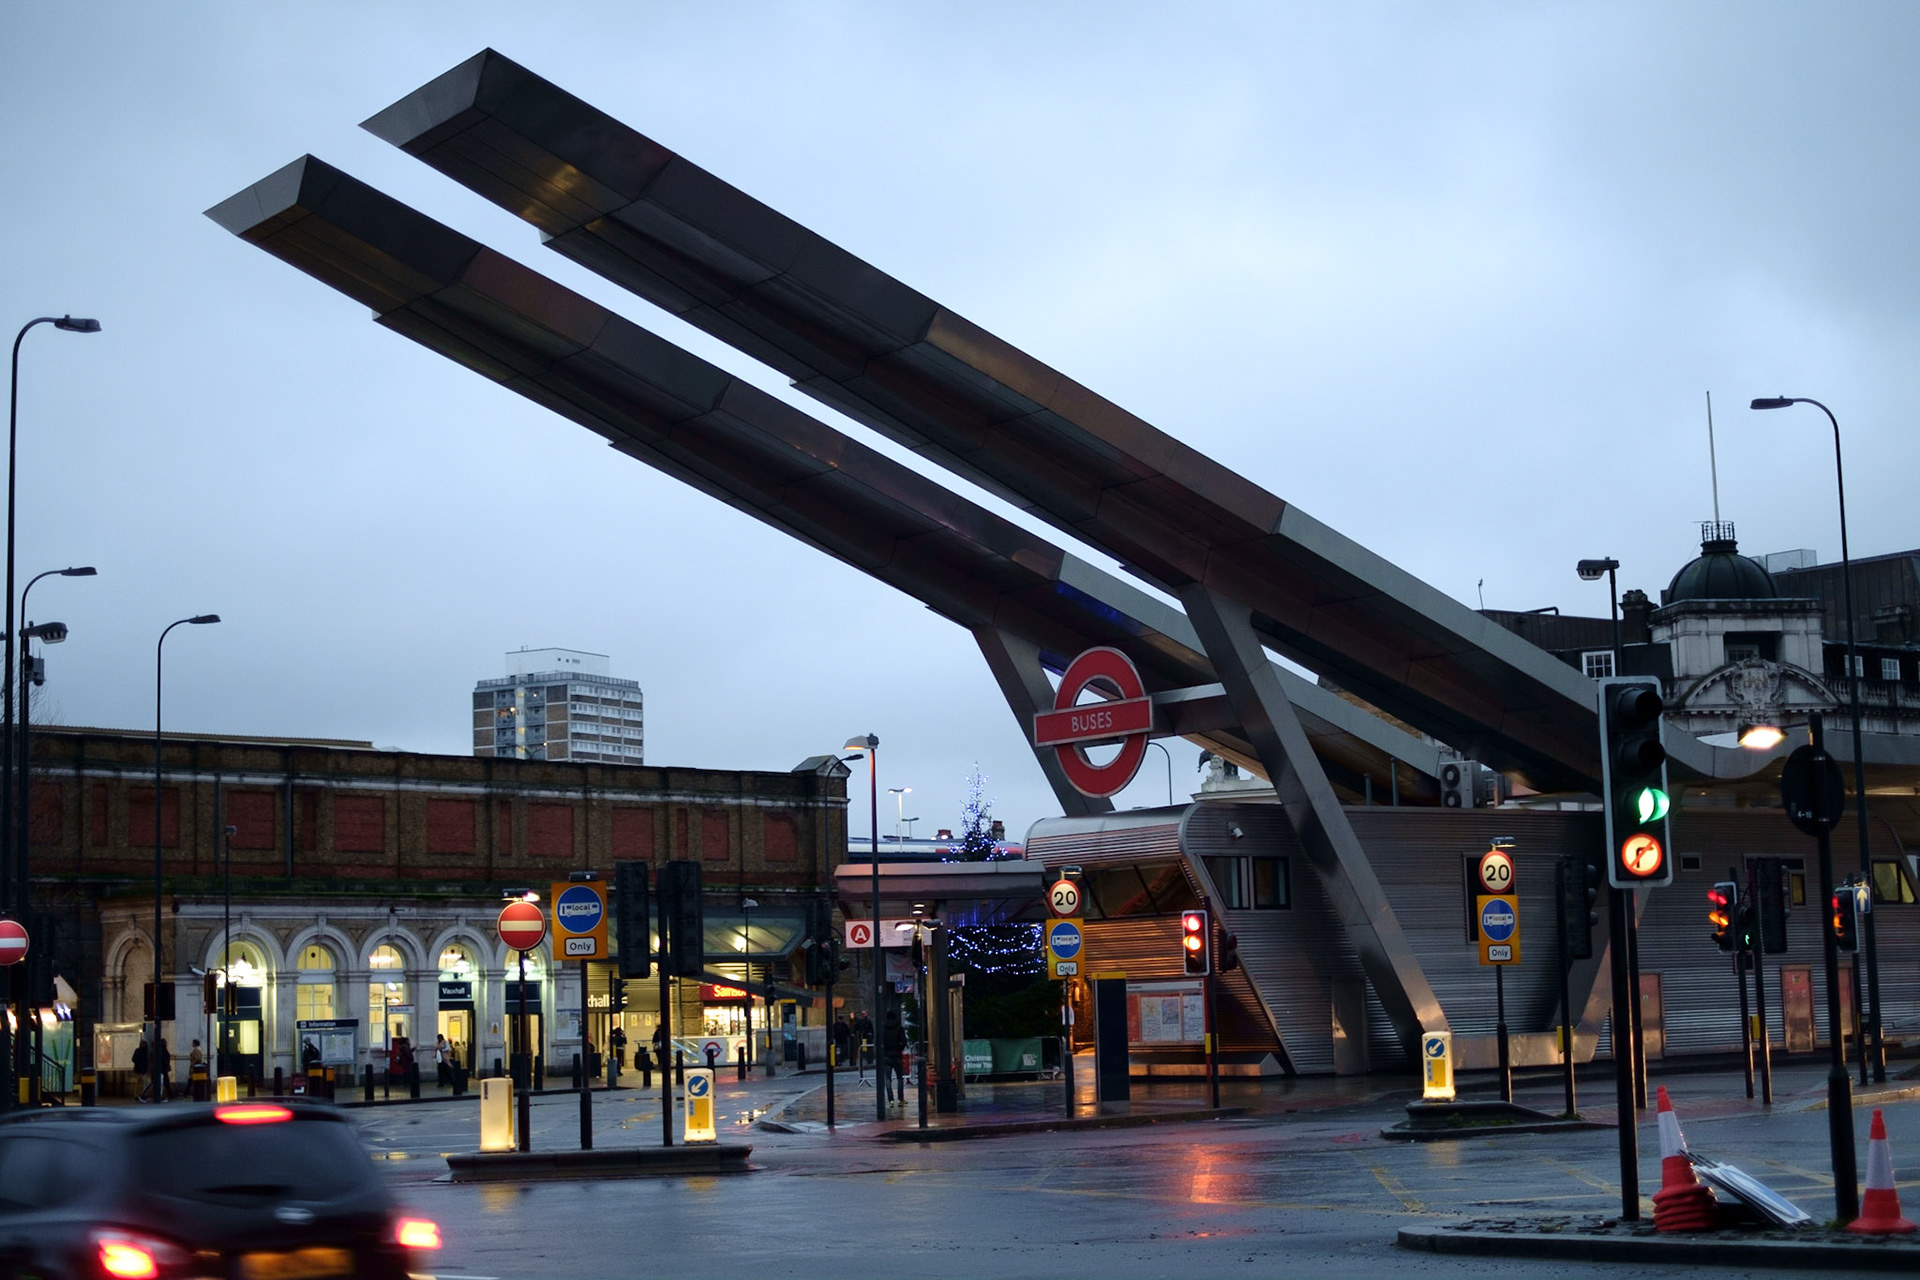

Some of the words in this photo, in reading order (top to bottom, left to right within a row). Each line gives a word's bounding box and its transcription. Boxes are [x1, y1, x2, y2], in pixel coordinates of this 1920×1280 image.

[1071, 711, 1113, 732] BUSES
[1485, 864, 1510, 881] 20
[1054, 890, 1077, 906] 20
[1492, 914, 1507, 922] local
[854, 927, 868, 942] A
[569, 942, 592, 951] Only
[1491, 949, 1509, 958] Only
[1059, 964, 1075, 973] Only
[441, 987, 466, 995] Vauxhall
